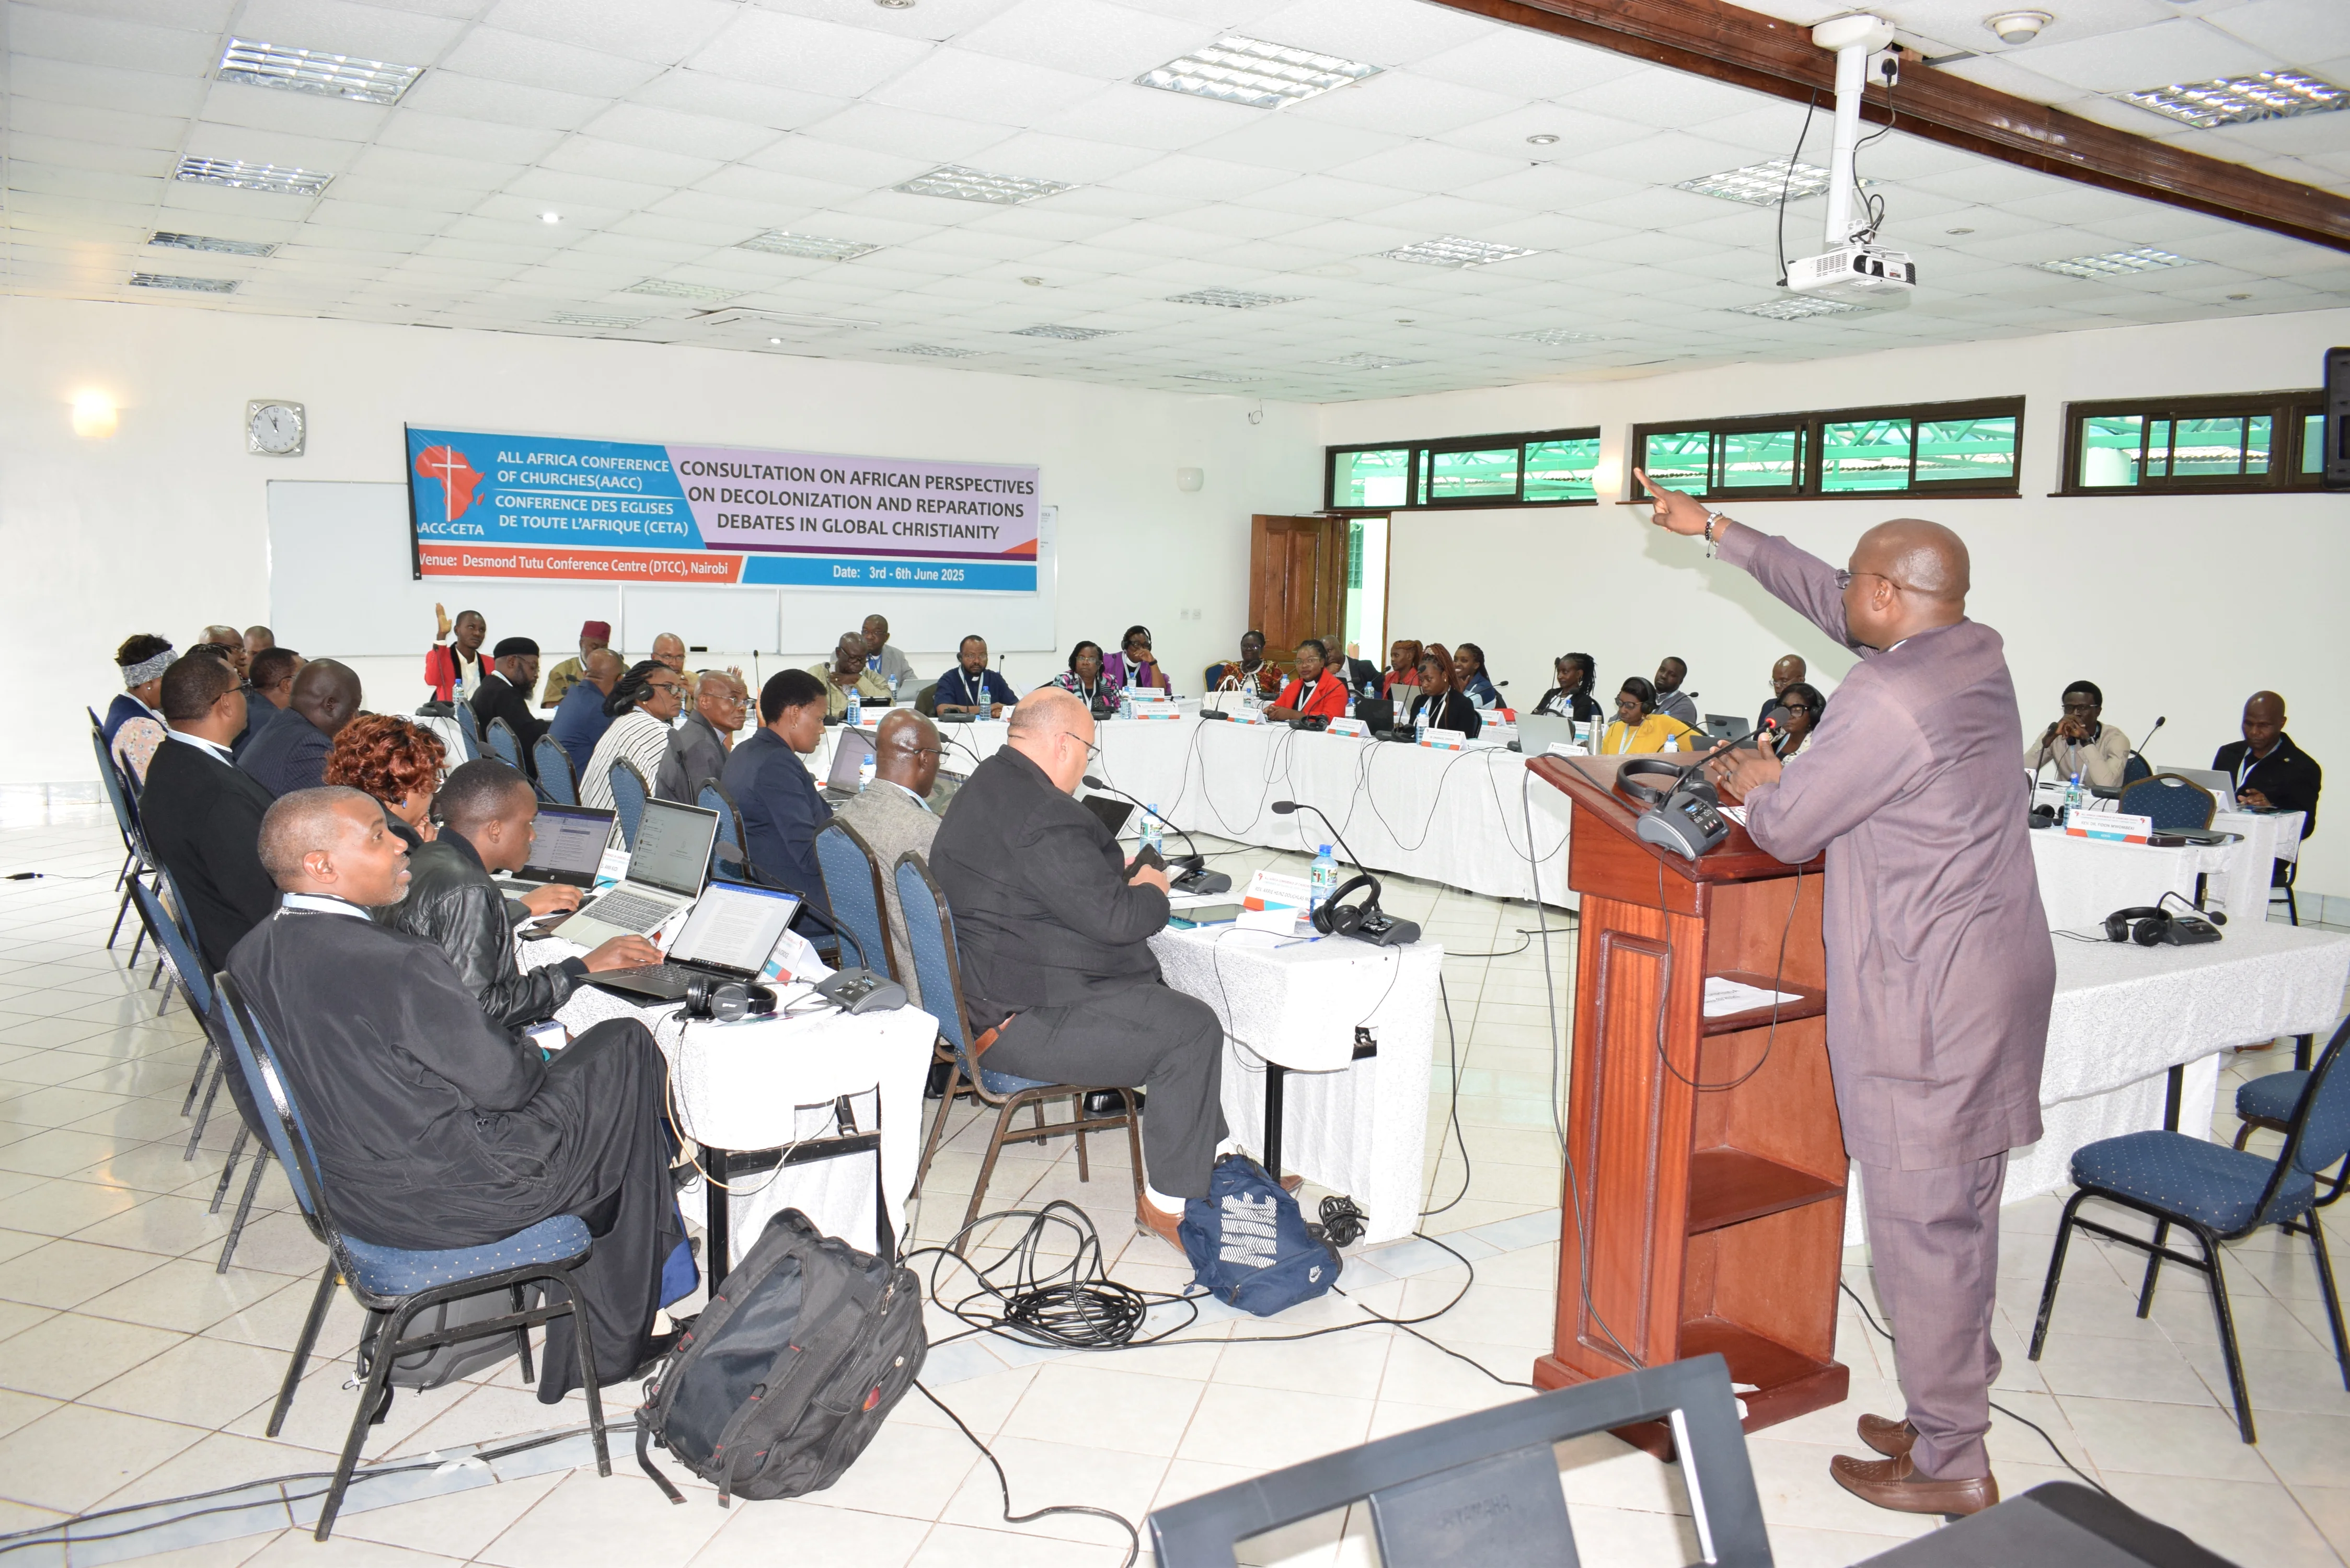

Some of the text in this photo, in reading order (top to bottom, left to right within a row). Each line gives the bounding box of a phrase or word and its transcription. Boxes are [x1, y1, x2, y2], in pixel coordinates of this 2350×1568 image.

[497, 451, 669, 472] ALL AFRICA CONFERENCE
[497, 470, 642, 491] OF CHURCHES(AACC)
[680, 460, 1034, 495] CONSULTATION ON AFRICAN PERSPECTIVES
[495, 495, 673, 515] CONFERENCE DES EGLISES
[688, 486, 1024, 517] ON DECOLONIZATION AND REPARATIONS
[499, 515, 517, 527] DE
[521, 516, 568, 529] TOUTE
[644, 520, 688, 536] (CETA)
[718, 513, 999, 539] DEBATES IN GLOBAL CHRISTIANITY
[419, 553, 728, 576] Venue: Desmond Tutu Conference Centre (DTCC), Nairobi
[833, 565, 861, 579] Date:
[869, 566, 886, 579] 3rd
[895, 567, 912, 579] 6th
[914, 568, 939, 580] June
[941, 569, 964, 581] 2025
